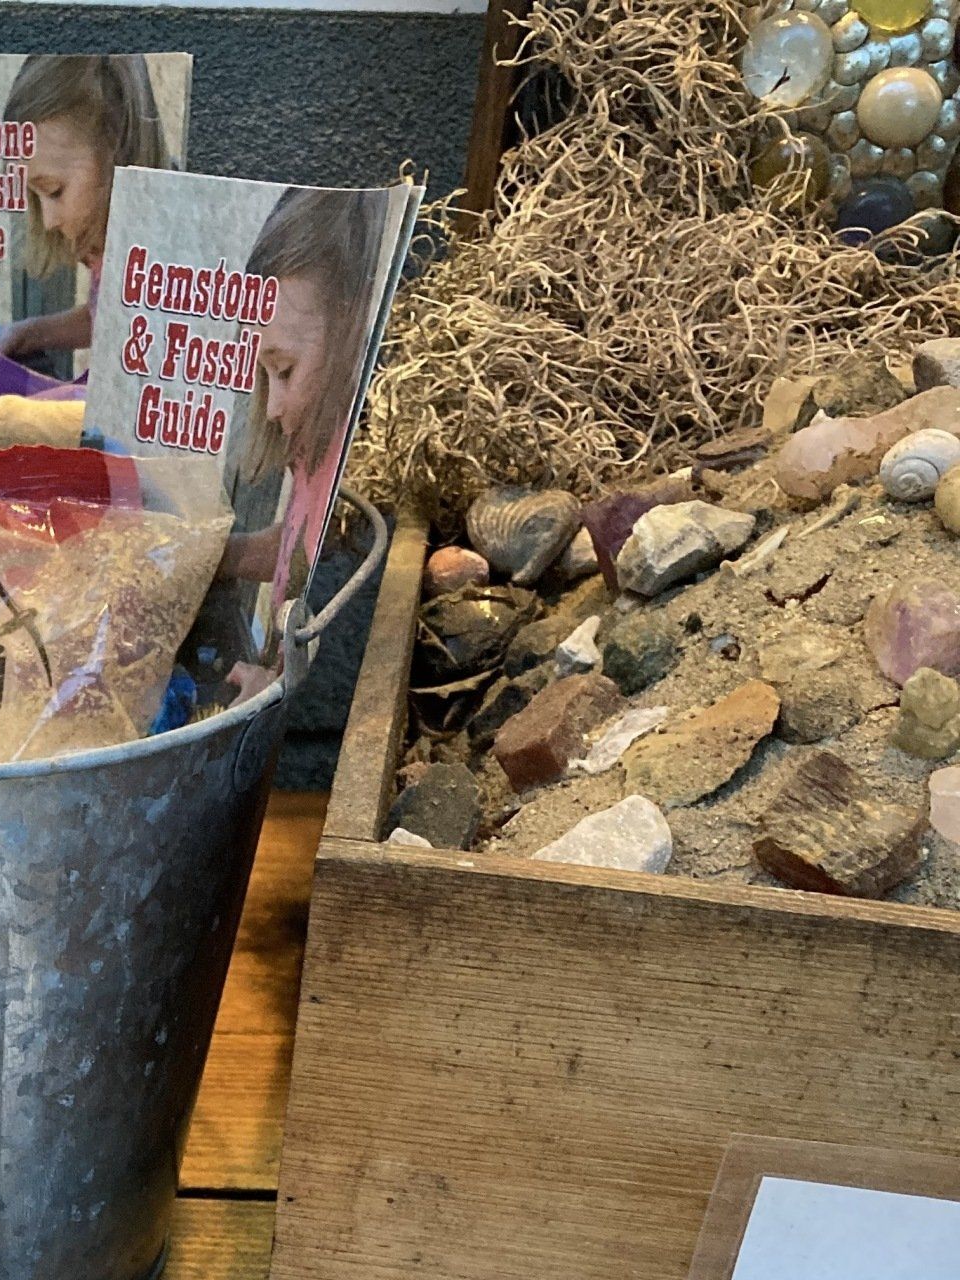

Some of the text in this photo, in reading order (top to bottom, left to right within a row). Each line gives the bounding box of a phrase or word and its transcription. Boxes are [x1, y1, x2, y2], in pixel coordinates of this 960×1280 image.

[122, 246, 278, 326] Gemstone
[122, 316, 261, 393] & Fossil
[136, 385, 226, 453] Guide
